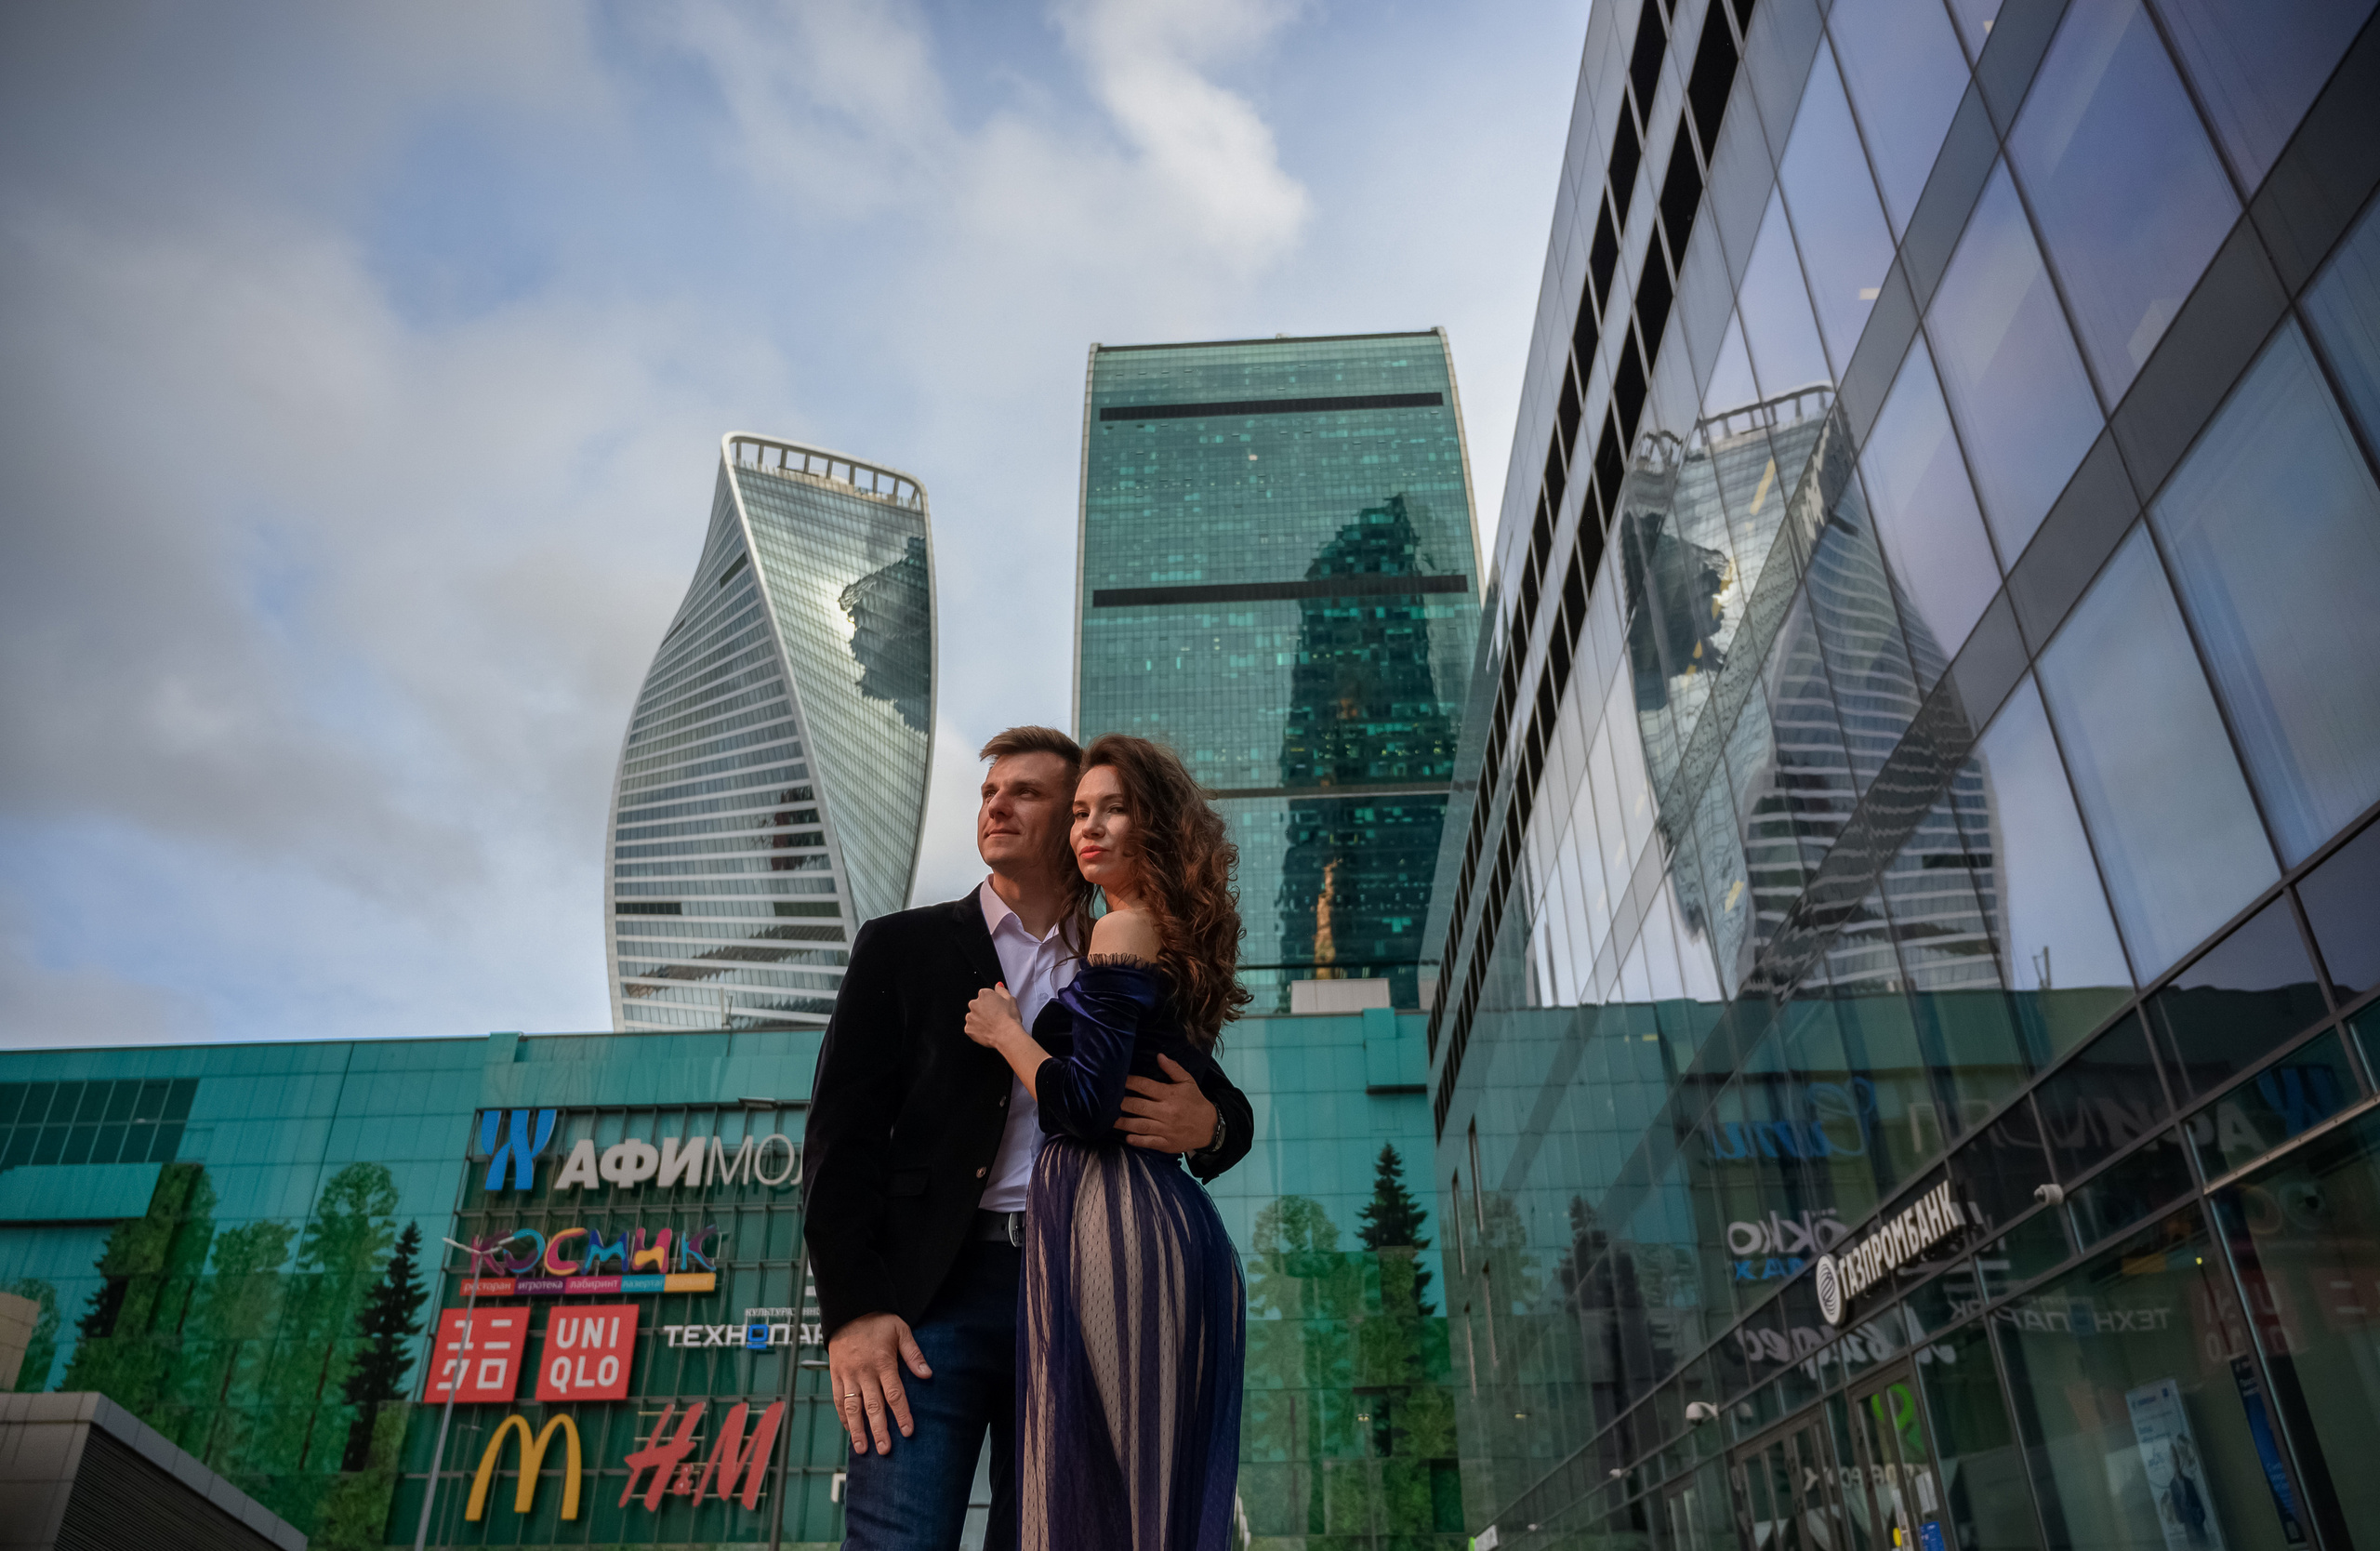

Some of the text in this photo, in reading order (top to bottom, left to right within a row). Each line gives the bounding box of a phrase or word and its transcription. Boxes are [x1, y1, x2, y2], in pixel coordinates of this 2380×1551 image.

[469, 1225, 719, 1277] КОСМИК
[1837, 1179, 1959, 1301] ГАЗПРОМБАНК
[464, 1279, 511, 1292] ресторан
[518, 1279, 563, 1292] игротека
[569, 1277, 619, 1291] лабиринт
[746, 1307, 794, 1317] КУЛЬТУРА
[555, 1316, 621, 1349] UNI
[549, 1355, 620, 1394] QLO
[617, 1400, 787, 1513] H&M
